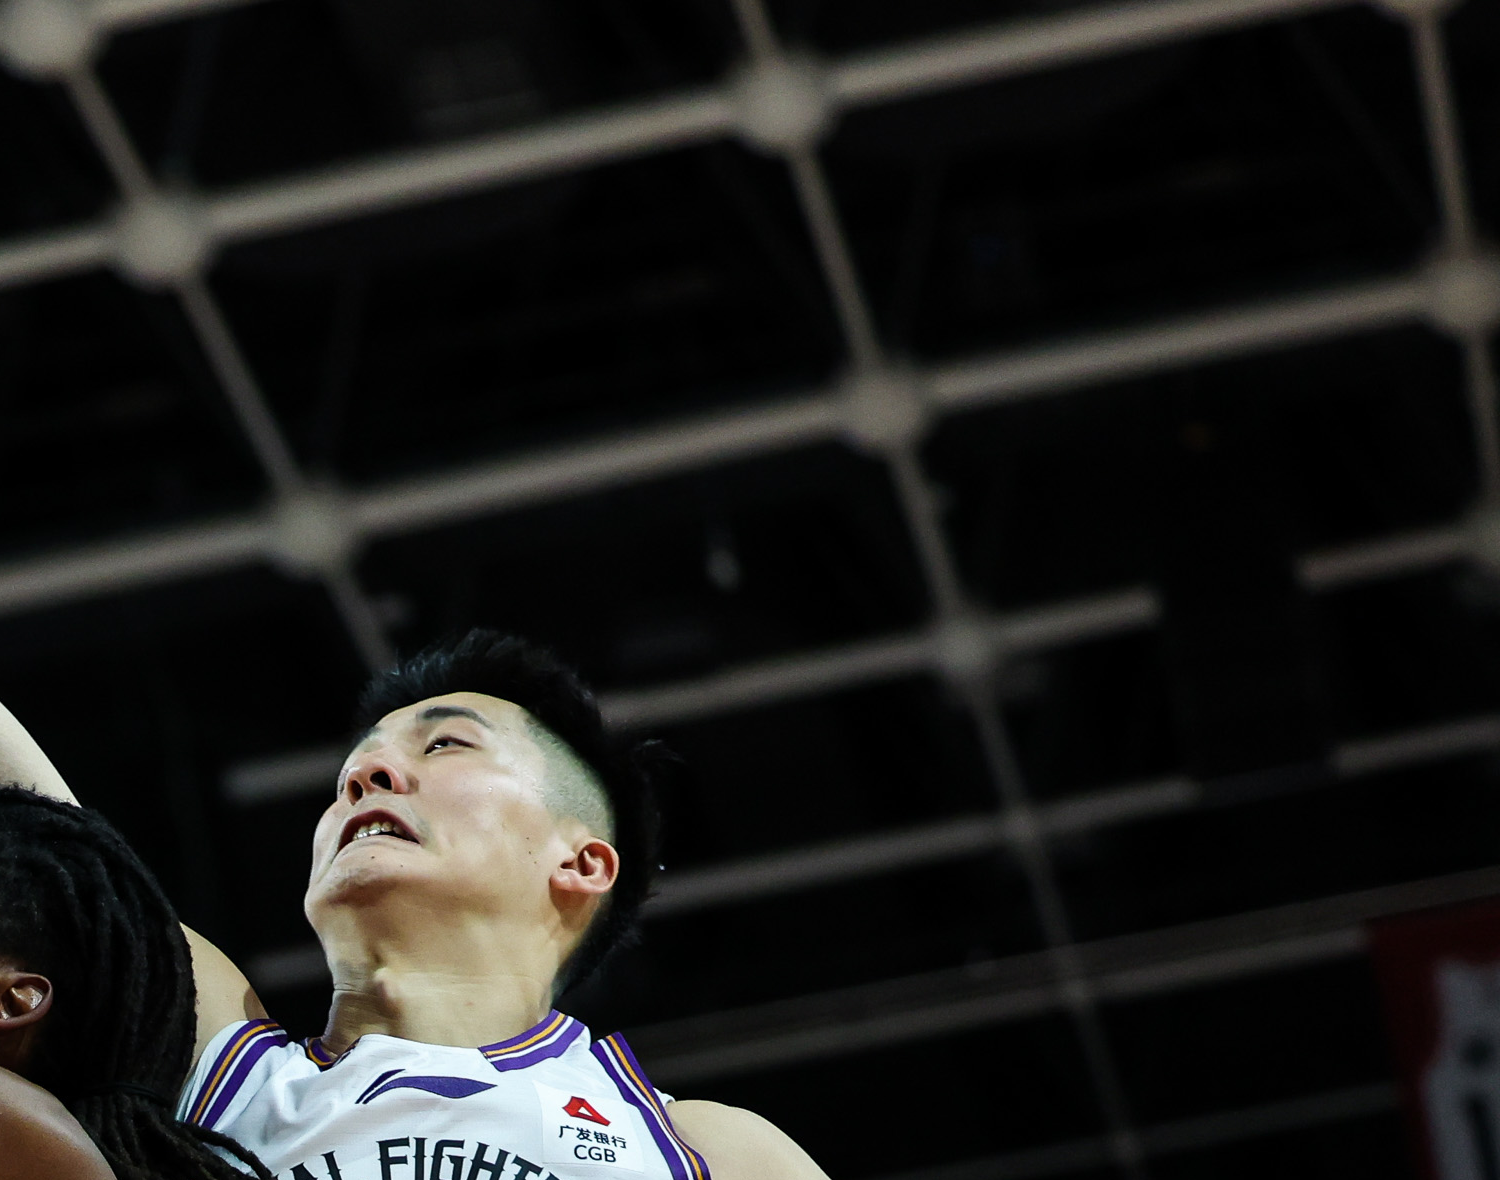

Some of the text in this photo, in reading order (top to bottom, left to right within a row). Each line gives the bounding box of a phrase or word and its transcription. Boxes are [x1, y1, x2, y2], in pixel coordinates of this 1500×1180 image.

[558, 1124, 627, 1149] 广发银行
[573, 1144, 617, 1163] CGB
